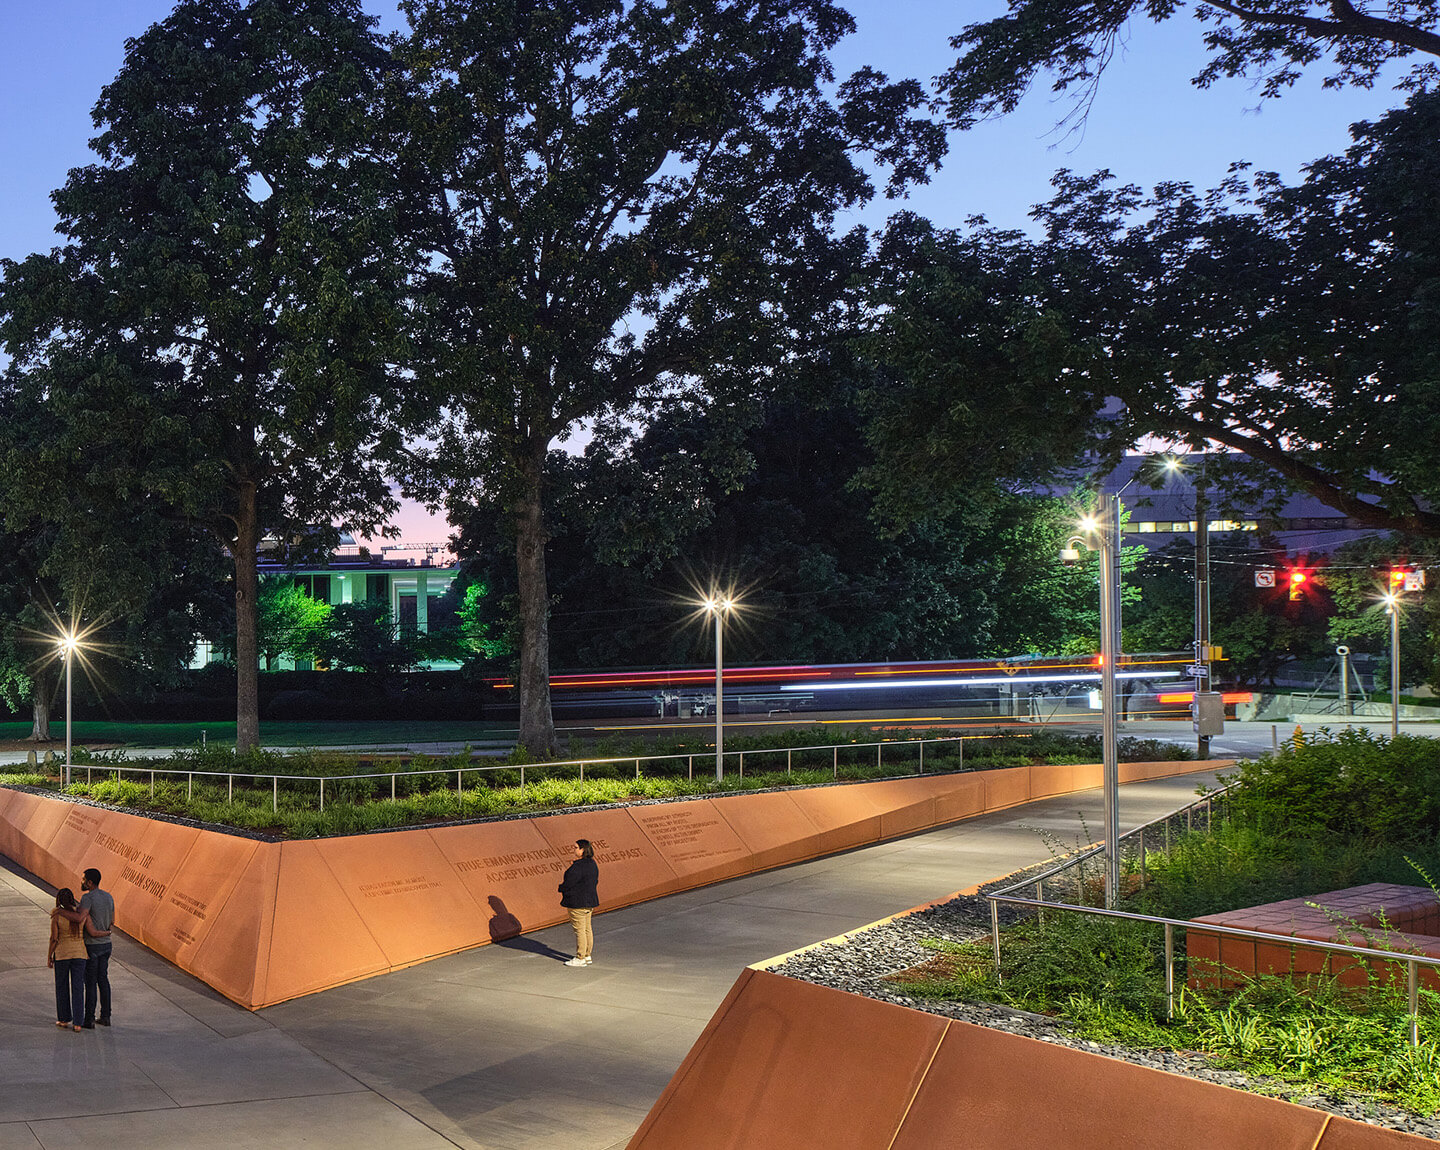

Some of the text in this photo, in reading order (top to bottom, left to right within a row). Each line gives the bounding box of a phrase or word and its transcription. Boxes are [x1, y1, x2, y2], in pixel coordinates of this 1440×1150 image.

[95, 831, 154, 870] THE FREEDOM OF THE
[454, 839, 610, 873] TRUE EMANCIPATION LIES THE
[486, 847, 647, 883] ACCEPTANCE OF HOLE PAST.
[121, 866, 146, 888] HUMAN
